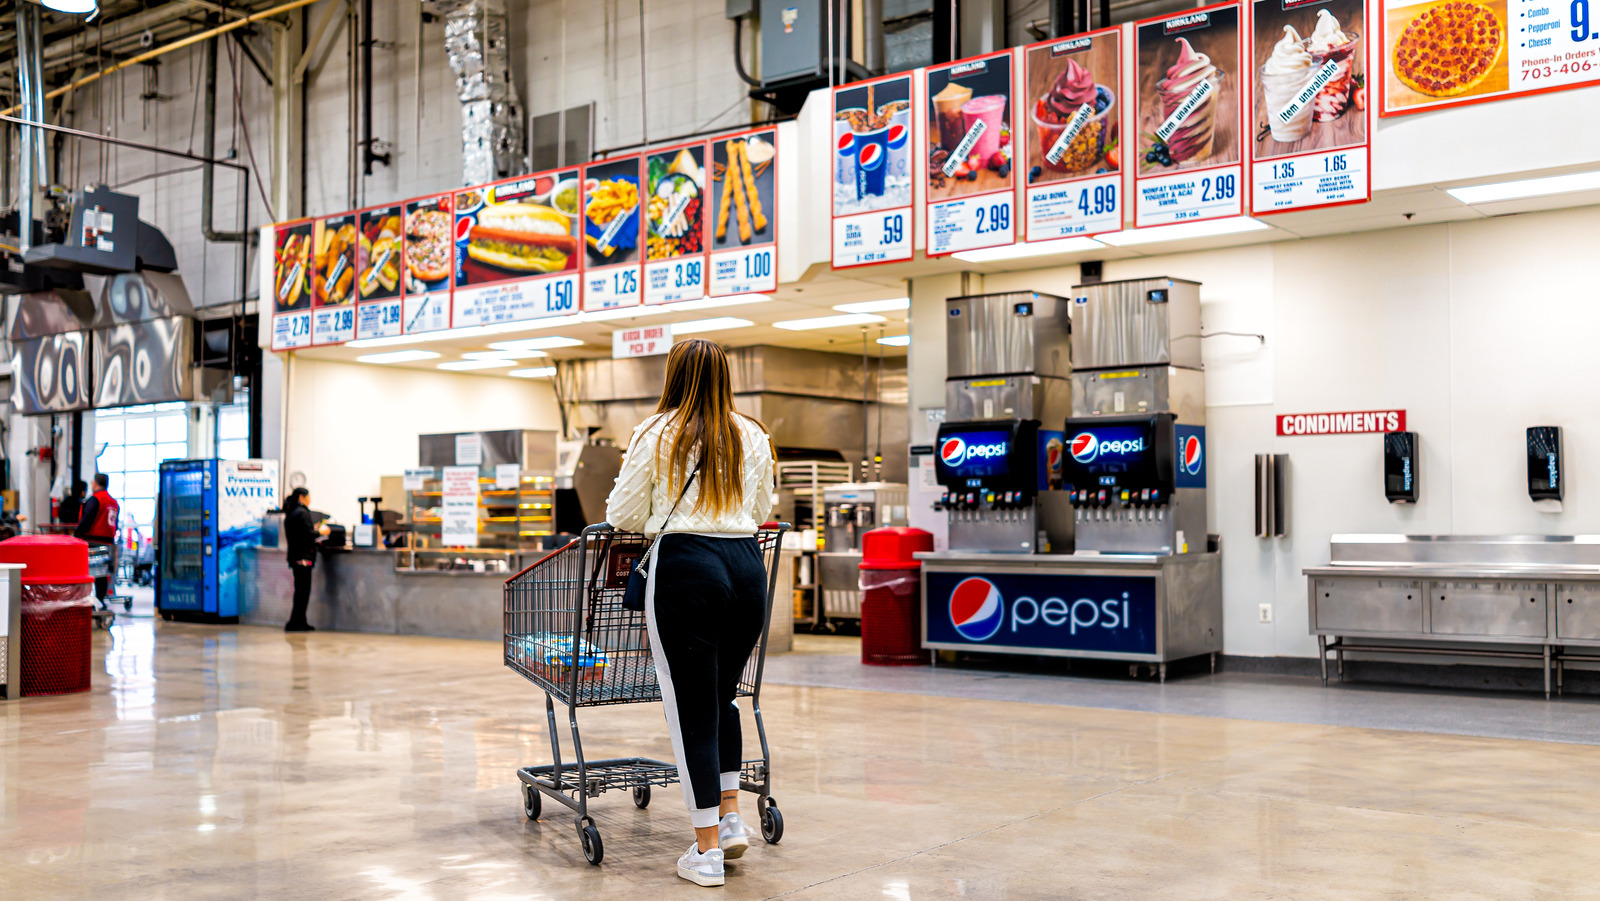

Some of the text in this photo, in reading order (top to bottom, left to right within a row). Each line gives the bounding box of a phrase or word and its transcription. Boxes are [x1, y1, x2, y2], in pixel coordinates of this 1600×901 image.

[1166, 13, 1209, 29] KIRKLAND
[1527, 7, 1550, 18] Combo
[1528, 18, 1561, 34] Pepperoni
[1053, 38, 1091, 53] KIRKLAND
[1528, 37, 1552, 49] Cheese
[1521, 49, 1596, 68] Phone-In Orders
[1521, 60, 1600, 81] 703-406-
[1279, 63, 1338, 122] Item unavailable
[1158, 82, 1210, 138] Item unavailable
[1048, 107, 1091, 164] Item unavailable
[944, 122, 984, 176] Item unavailable
[1273, 161, 1295, 179] 1.35
[1324, 154, 1347, 172] 1.65
[495, 179, 535, 197] KIRKLAND
[1032, 190, 1068, 202] ACAI BOWL
[1142, 181, 1196, 194] NONFAT VANILLA
[1144, 192, 1169, 201] YOGURT
[1178, 189, 1193, 197] ACAI
[1201, 174, 1235, 202] 2.99
[1078, 184, 1116, 216] 4.99
[1158, 198, 1179, 206] SWIRL
[976, 203, 1010, 234] 2.99
[880, 214, 903, 245] .59
[675, 261, 701, 288] 3.99
[745, 251, 770, 278] 1.00
[614, 269, 637, 295] 1.25
[545, 280, 572, 311] 1.50
[334, 309, 353, 331] 2.99
[383, 305, 400, 324] 3.99
[292, 315, 310, 336] 2.79
[1282, 411, 1399, 435] CONDIMENTS
[967, 442, 1006, 459] pepsi
[1100, 437, 1143, 455] pepsi
[228, 474, 271, 483] Premium
[1547, 452, 1557, 488] napkins
[225, 486, 273, 497] WATER
[1011, 591, 1129, 635] pepsi
